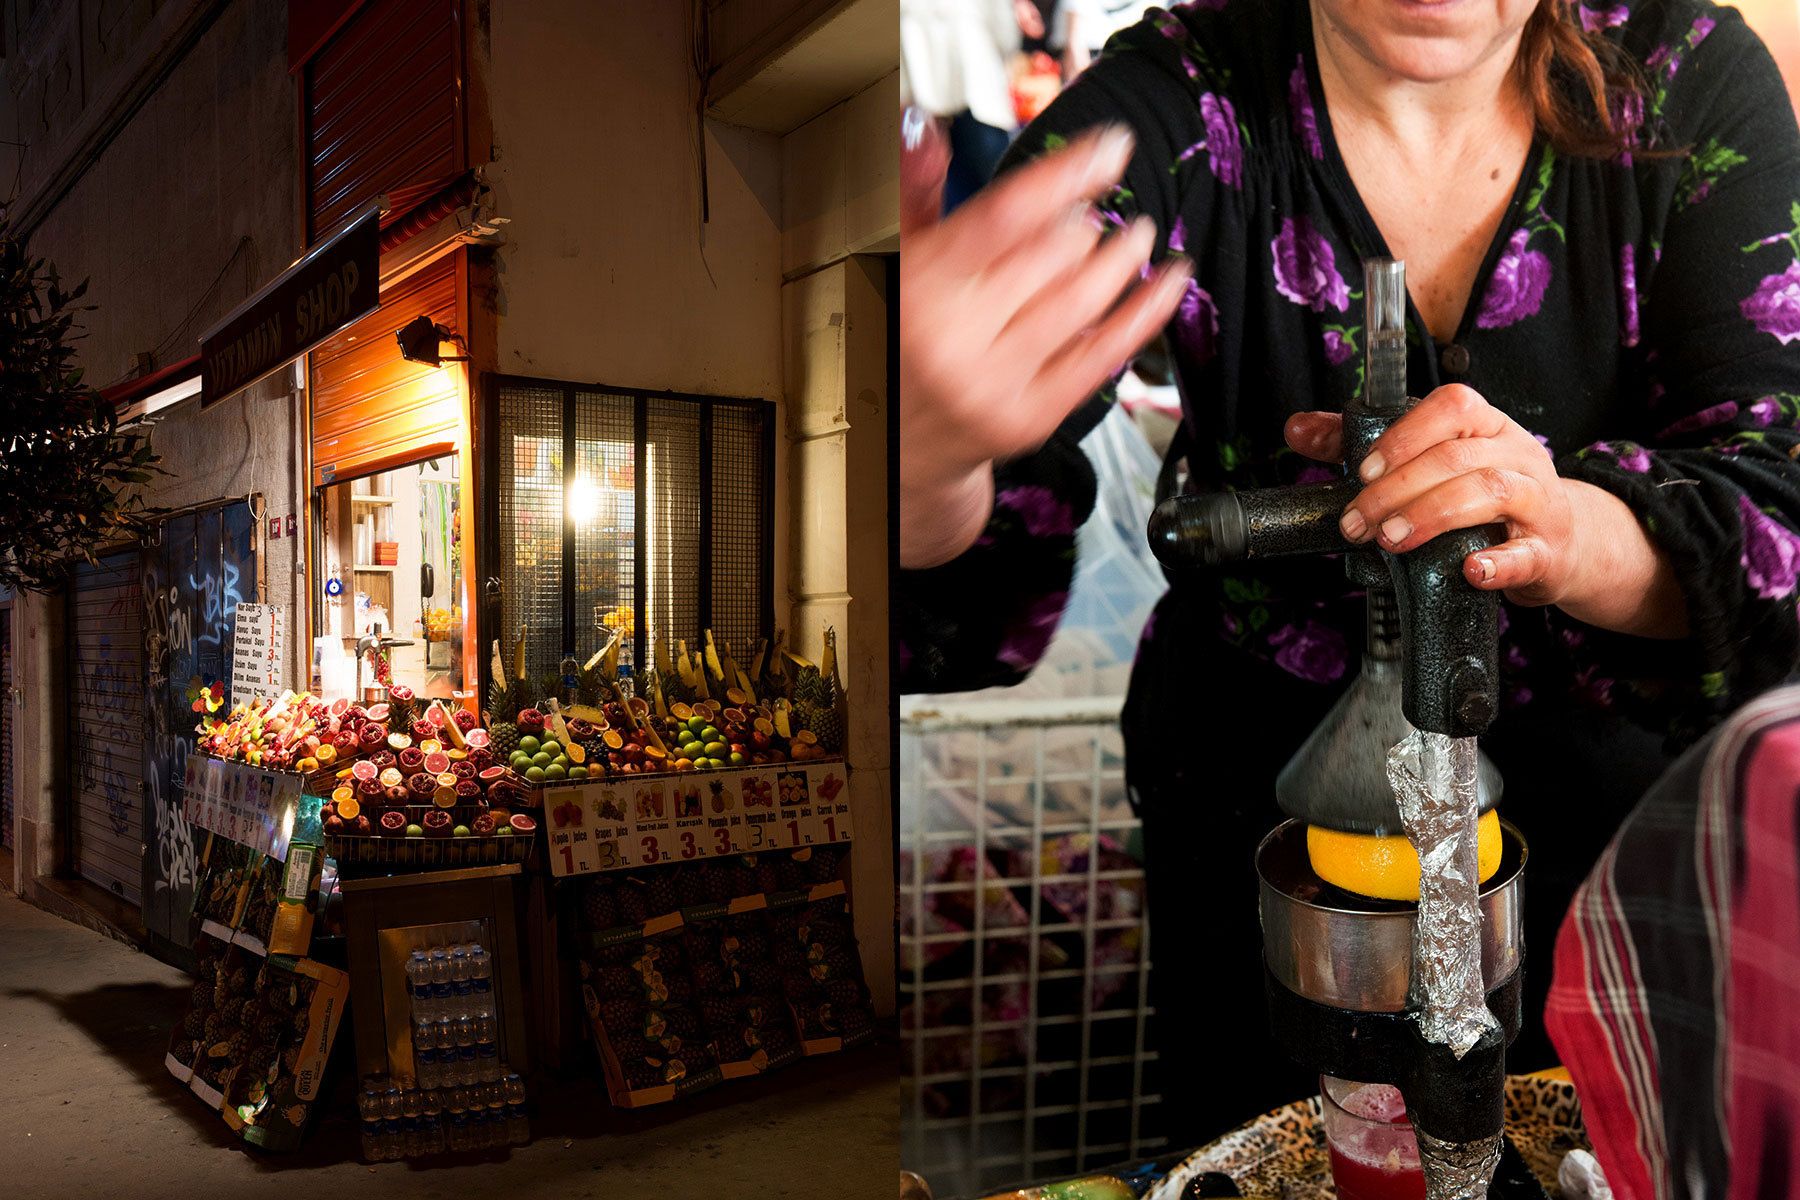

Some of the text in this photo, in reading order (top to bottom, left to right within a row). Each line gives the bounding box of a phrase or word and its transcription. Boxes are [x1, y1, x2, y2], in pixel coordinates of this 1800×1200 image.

[296, 260, 359, 343] SHOP
[237, 614, 247, 622] Elma
[236, 636, 252, 644] Portakal
[235, 648, 249, 656] Ananas
[268, 649, 274, 660] 3
[233, 685, 251, 694] Hindistan
[268, 674, 272, 684] 1
[817, 805, 832, 815] Carrot
[551, 831, 588, 845] Apple juice
[751, 825, 762, 846] 3
[787, 821, 800, 845] 1
[823, 817, 836, 841] 1
[641, 836, 659, 863] 3
[680, 832, 696, 858] 3
[714, 828, 731, 854] 3
[560, 846, 574, 874] 1
[600, 841, 615, 867] 3
